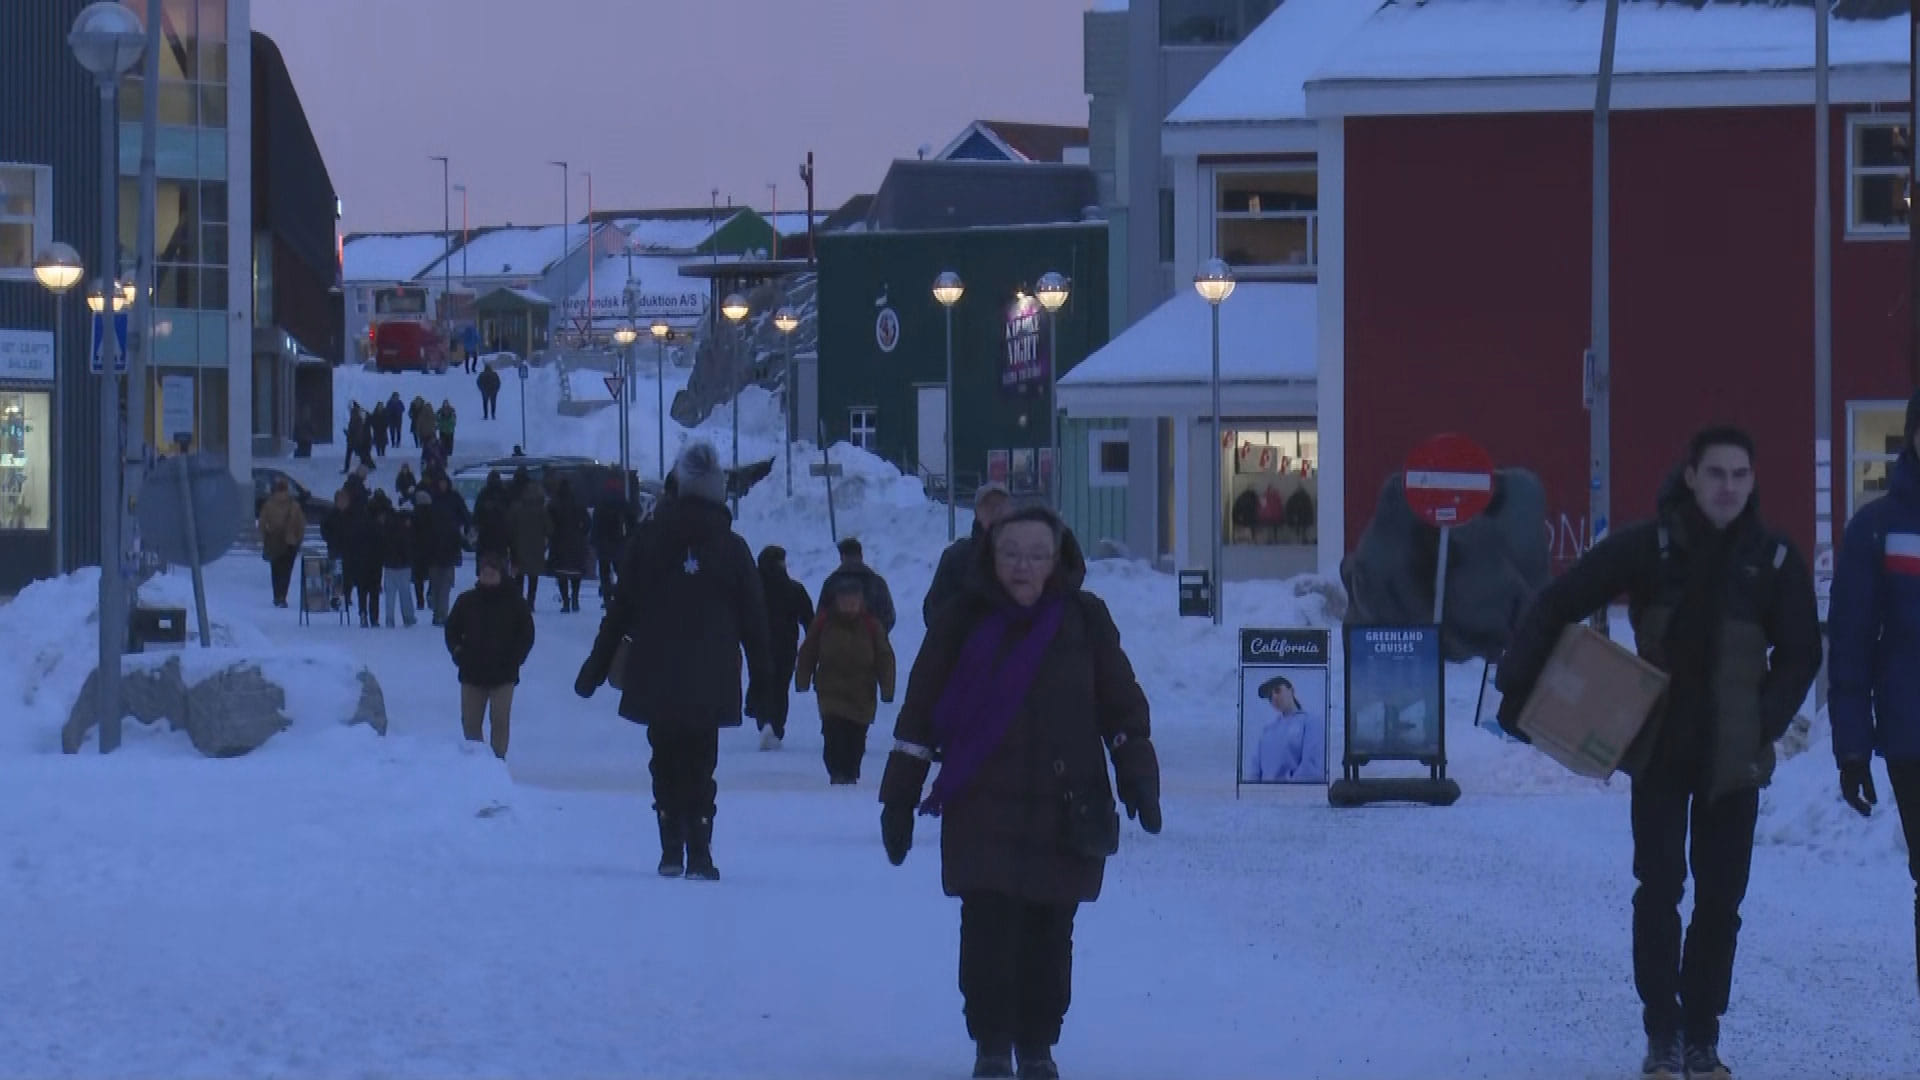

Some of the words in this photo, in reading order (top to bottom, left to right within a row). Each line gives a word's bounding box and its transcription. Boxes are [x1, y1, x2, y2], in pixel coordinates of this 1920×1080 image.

[679, 293, 697, 306] A/S
[1365, 631, 1424, 641] GREENLAND
[1250, 637, 1320, 657] California
[1374, 642, 1415, 653] CRUISES
